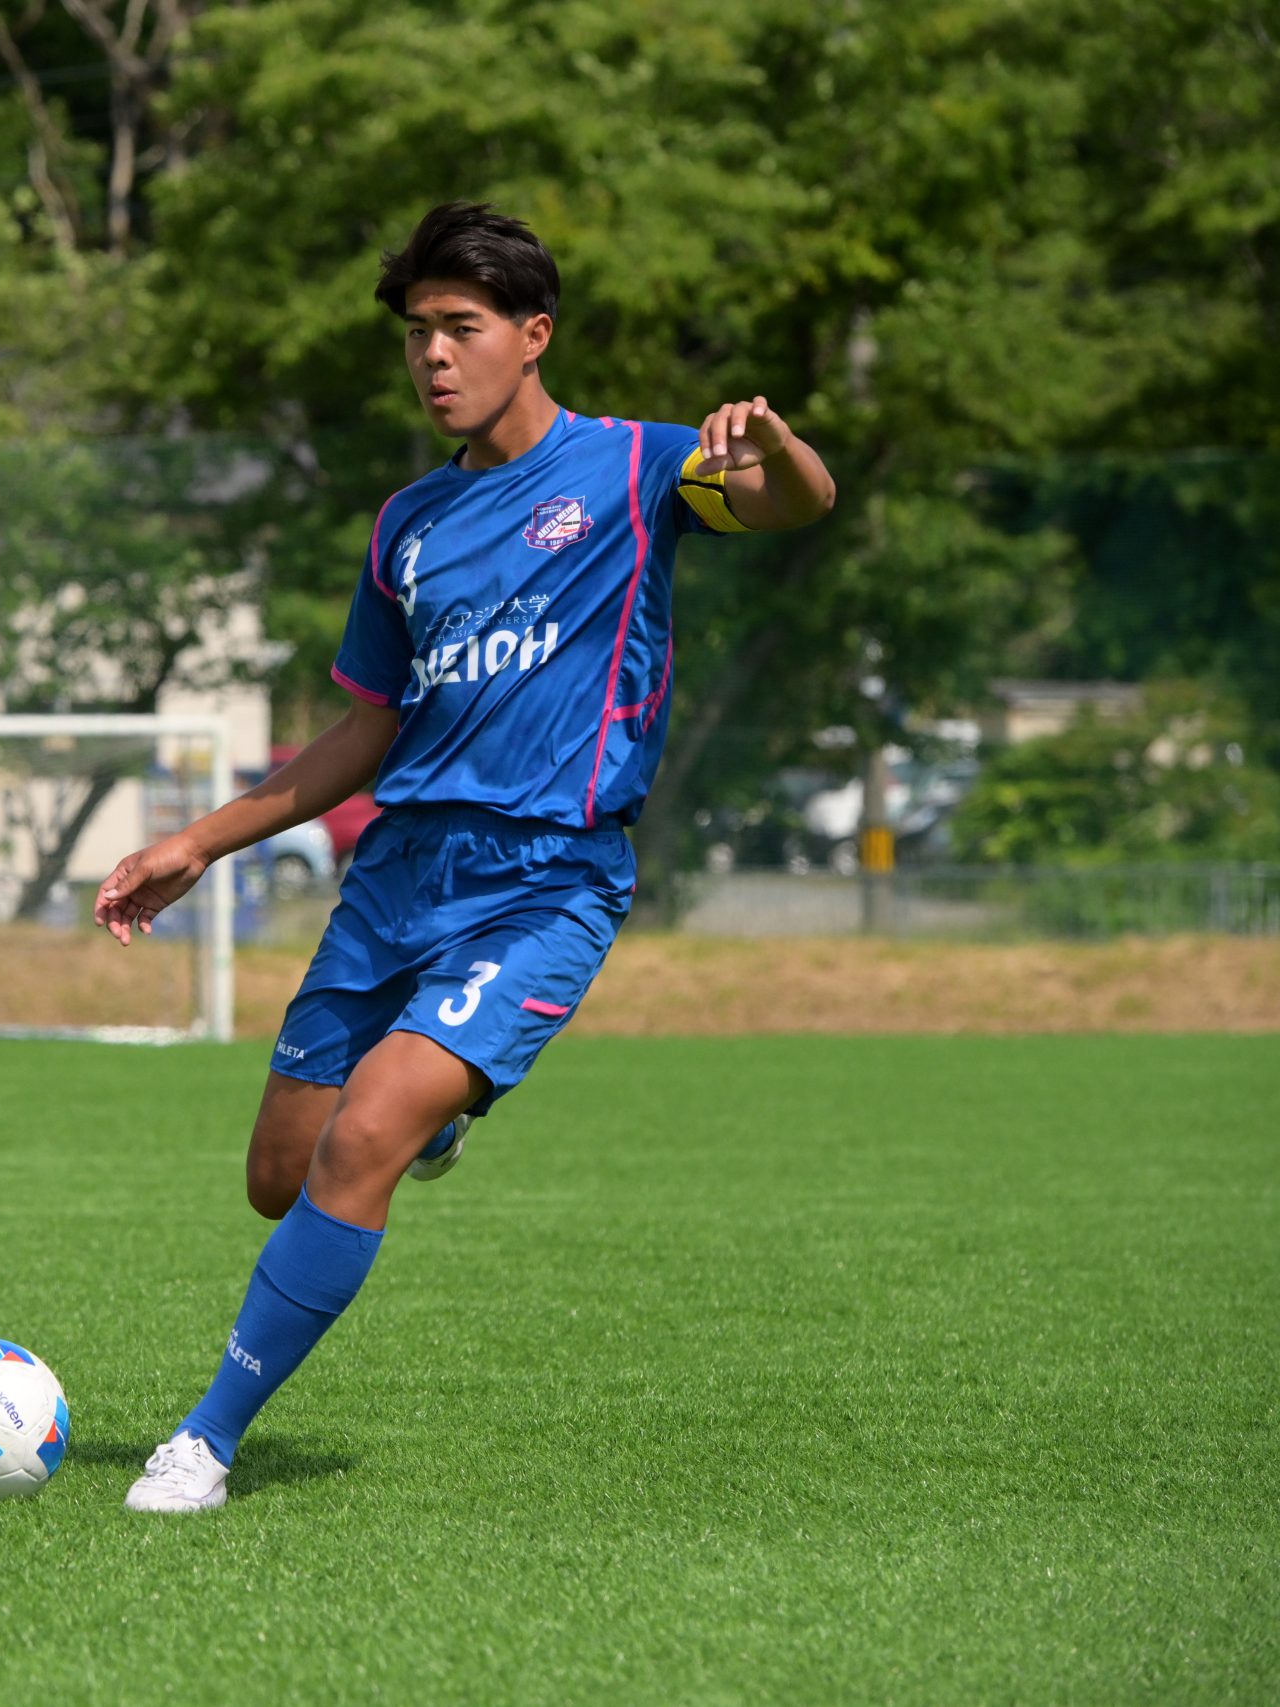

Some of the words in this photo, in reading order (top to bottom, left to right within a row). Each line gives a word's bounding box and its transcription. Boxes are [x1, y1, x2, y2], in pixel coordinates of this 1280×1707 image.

[536, 519, 559, 539] AKITA
[555, 501, 579, 522] MEIOH
[397, 539, 422, 616] 3
[451, 629, 473, 640] ASIA
[438, 961, 501, 1026] 3
[277, 1041, 304, 1060] HLETA
